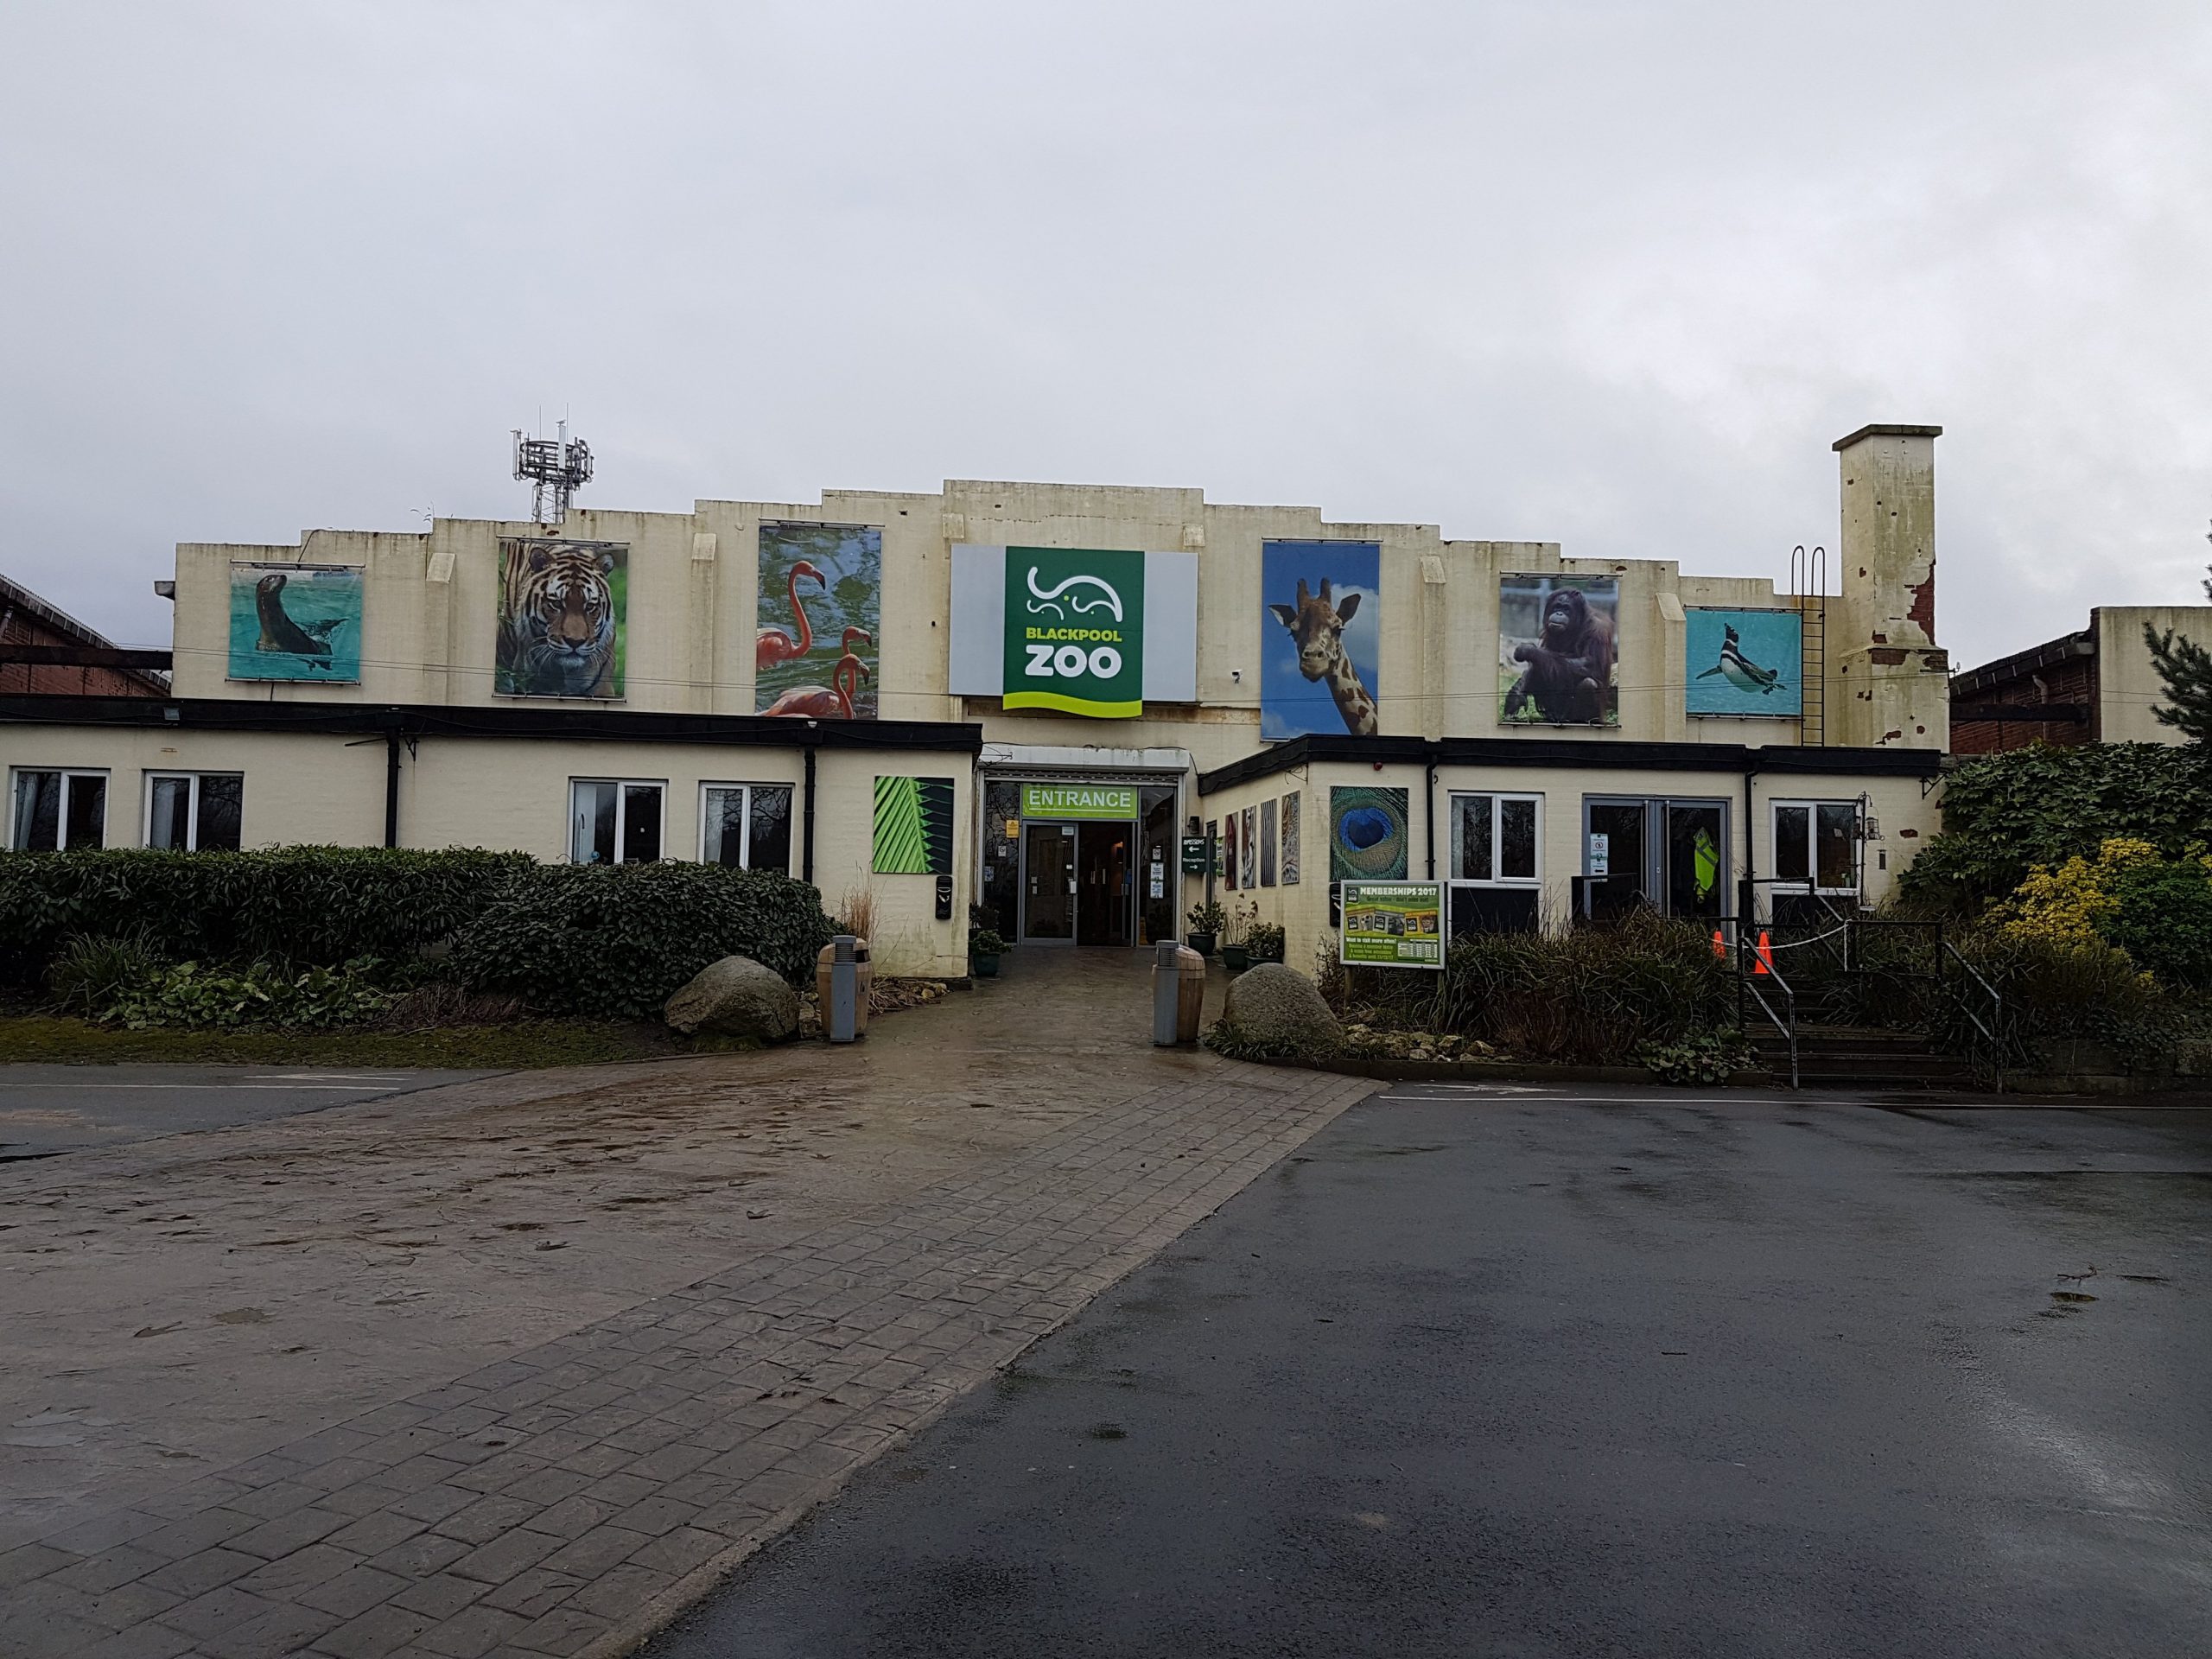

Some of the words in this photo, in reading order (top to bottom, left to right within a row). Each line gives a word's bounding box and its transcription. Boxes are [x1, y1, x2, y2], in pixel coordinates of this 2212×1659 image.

[1026, 626, 1122, 642] BLACKPOOL
[1025, 645, 1122, 679] ZOO
[1029, 790, 1131, 808] ENTRANCE
[1360, 887, 1417, 896] MEMBERSHIPS
[1418, 887, 1437, 896] 2017
